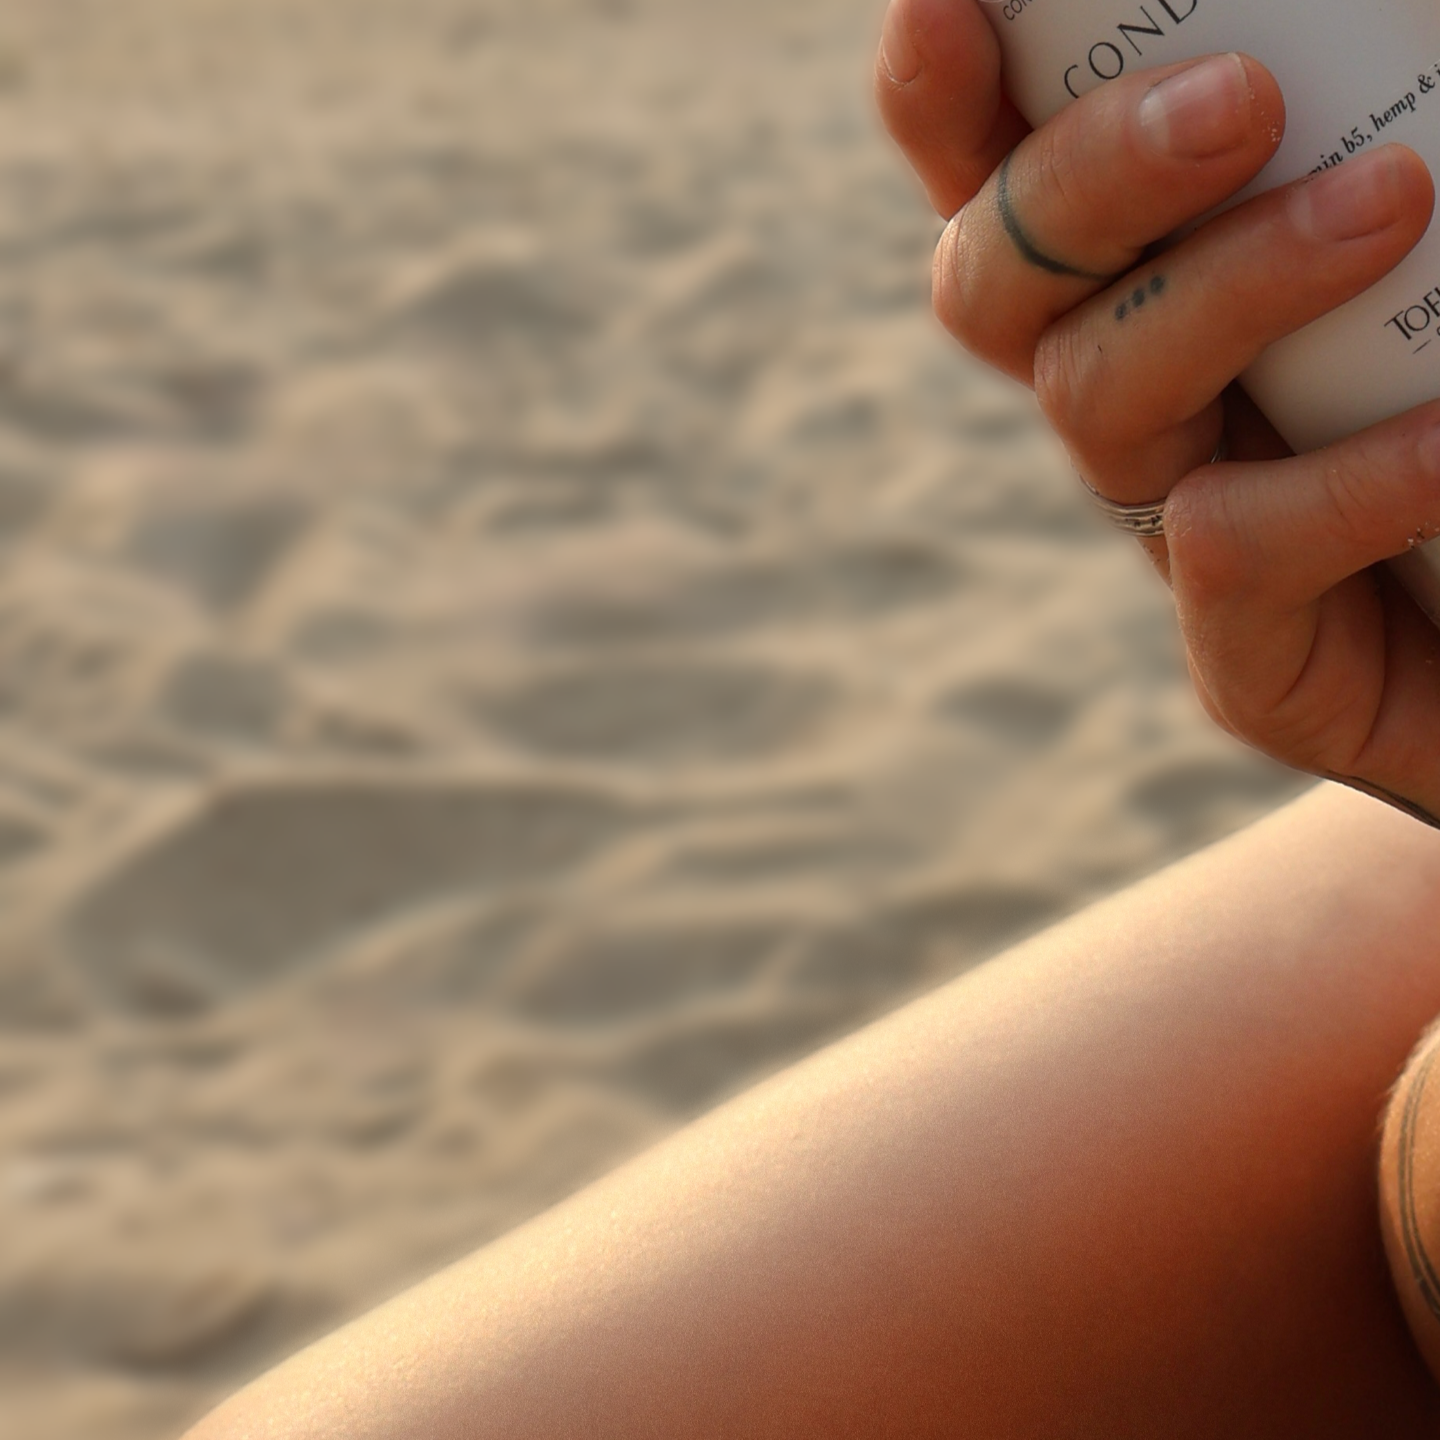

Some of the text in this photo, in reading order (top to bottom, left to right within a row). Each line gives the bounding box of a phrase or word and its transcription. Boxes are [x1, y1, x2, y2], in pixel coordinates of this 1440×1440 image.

[1340, 126, 1373, 154] b5,
[1369, 91, 1416, 132] hemp
[1417, 73, 1436, 94] &
